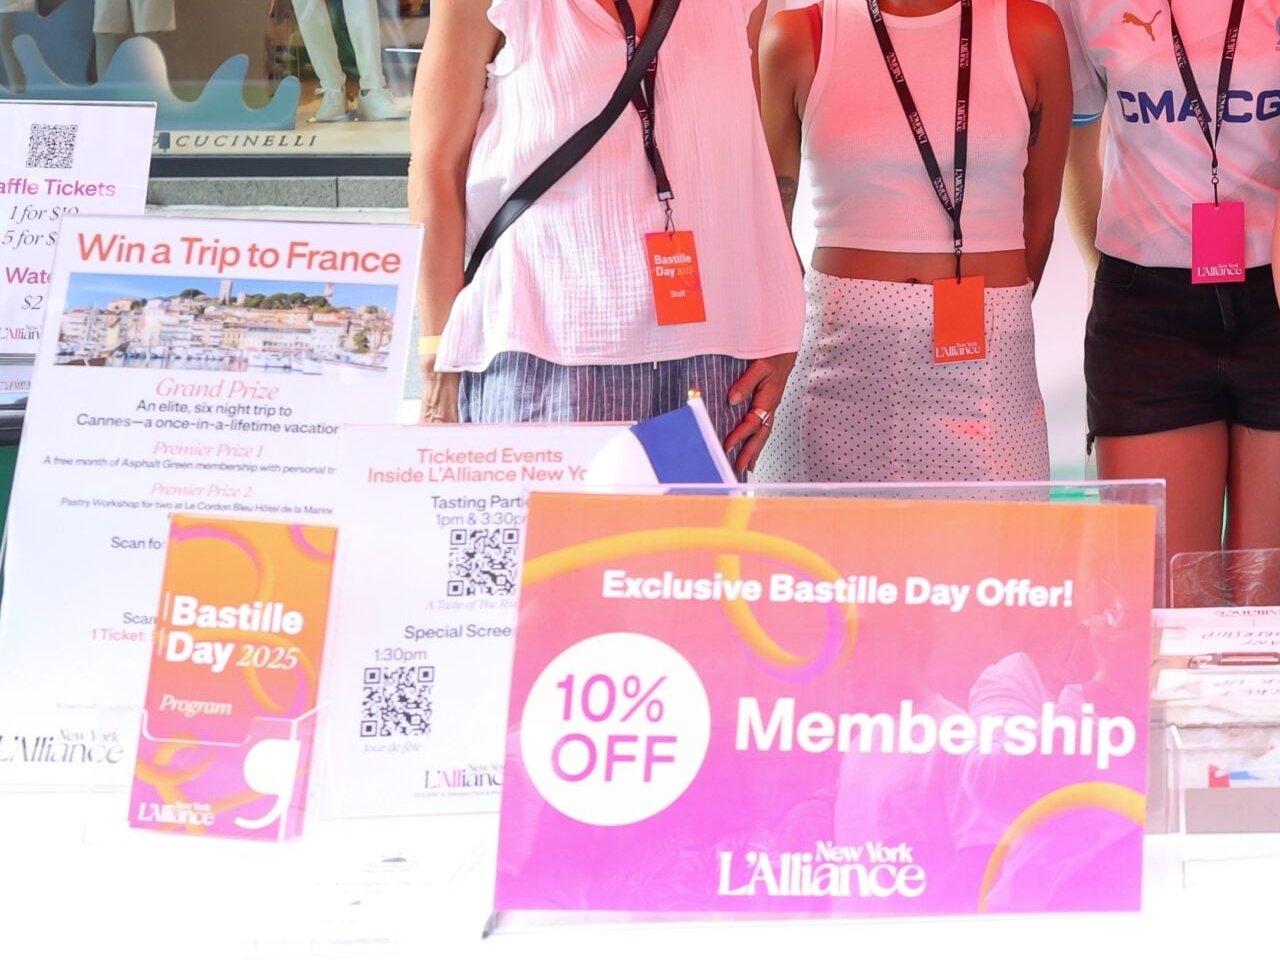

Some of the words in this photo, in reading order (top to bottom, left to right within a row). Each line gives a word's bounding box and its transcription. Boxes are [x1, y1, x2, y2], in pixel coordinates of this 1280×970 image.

[175, 134, 317, 148] CUCINELLI
[44, 179, 116, 198] Tickets
[8, 205, 18, 220] 1
[17, 204, 47, 224] for
[1, 230, 15, 245] 5
[12, 230, 44, 249] for
[77, 232, 145, 263] Win
[151, 245, 172, 265] a
[180, 236, 241, 274] Trip
[247, 243, 280, 268] to
[286, 241, 402, 275] France
[654, 254, 692, 265] Bastille
[655, 266, 676, 278] Day
[670, 289, 687, 299] Staff
[155, 377, 224, 398] Grand
[227, 379, 280, 400] Prize
[136, 399, 157, 412] An
[159, 400, 192, 415] elite,
[194, 402, 213, 414] six
[215, 403, 251, 418] night
[253, 404, 276, 418] trip
[279, 406, 293, 417] to
[155, 416, 284, 433] once-in-a-lifetime
[153, 440, 214, 457] Premier
[216, 442, 254, 458] Prize
[417, 448, 496, 464] Ticketed
[501, 448, 562, 463] Events
[43, 456, 51, 464] A
[53, 456, 74, 465] free
[74, 457, 108, 466] month
[109, 458, 121, 467] of
[121, 458, 160, 470] Asphalt
[162, 460, 193, 470] Green
[194, 461, 258, 476] membership
[259, 463, 281, 472] with
[282, 464, 326, 475] personal
[368, 467, 424, 483] Inside
[428, 466, 517, 482] L'Alliance
[521, 466, 563, 481] New
[150, 482, 205, 496] Premier
[207, 484, 240, 498] Prize
[242, 485, 253, 498] 2
[61, 497, 90, 508] Pastry
[92, 498, 140, 510] Workshop
[141, 500, 153, 508] for
[155, 501, 173, 509] two
[174, 501, 183, 509] at
[185, 502, 195, 510] Le
[197, 502, 231, 511] Cordon
[233, 503, 254, 512] Bleu
[281, 505, 292, 513] de
[294, 505, 302, 513] la
[431, 495, 486, 511] Tasting
[436, 513, 464, 528] 1pm
[467, 513, 477, 525] &
[111, 536, 145, 549] Scan
[601, 569, 762, 601] Exclusive
[769, 573, 898, 604] Bastille
[904, 576, 970, 612] Day
[975, 577, 1074, 608] Offer!
[123, 612, 157, 624] Scan
[171, 595, 304, 635] Bastille
[404, 625, 463, 641] Special
[466, 624, 512, 638] Scree
[166, 631, 235, 673] Day
[236, 644, 301, 670] 2025
[375, 647, 427, 663] 1:30pm
[159, 694, 232, 718] Program
[554, 673, 669, 723] 10%
[734, 696, 1137, 769] Membership
[550, 732, 678, 783] OFF
[815, 841, 862, 862] New
[864, 841, 914, 862] York
[717, 850, 926, 898] L'Alliance
